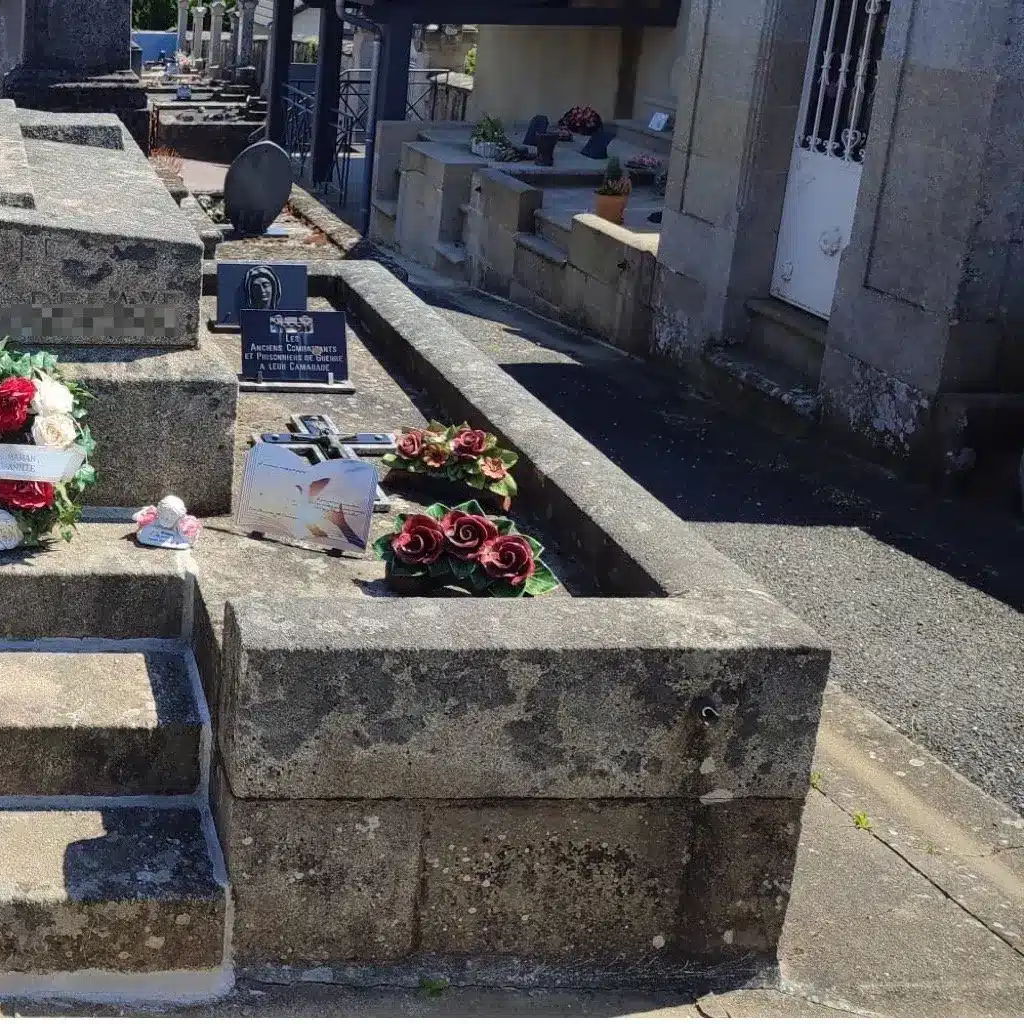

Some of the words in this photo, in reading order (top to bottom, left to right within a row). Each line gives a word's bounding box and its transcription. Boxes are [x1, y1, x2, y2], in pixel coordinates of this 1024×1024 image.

[250, 343, 283, 352] ANCIENS
[256, 352, 302, 362] PRISONNIERS
[316, 354, 344, 362] GUERRE
[289, 361, 331, 372] CAMARADE
